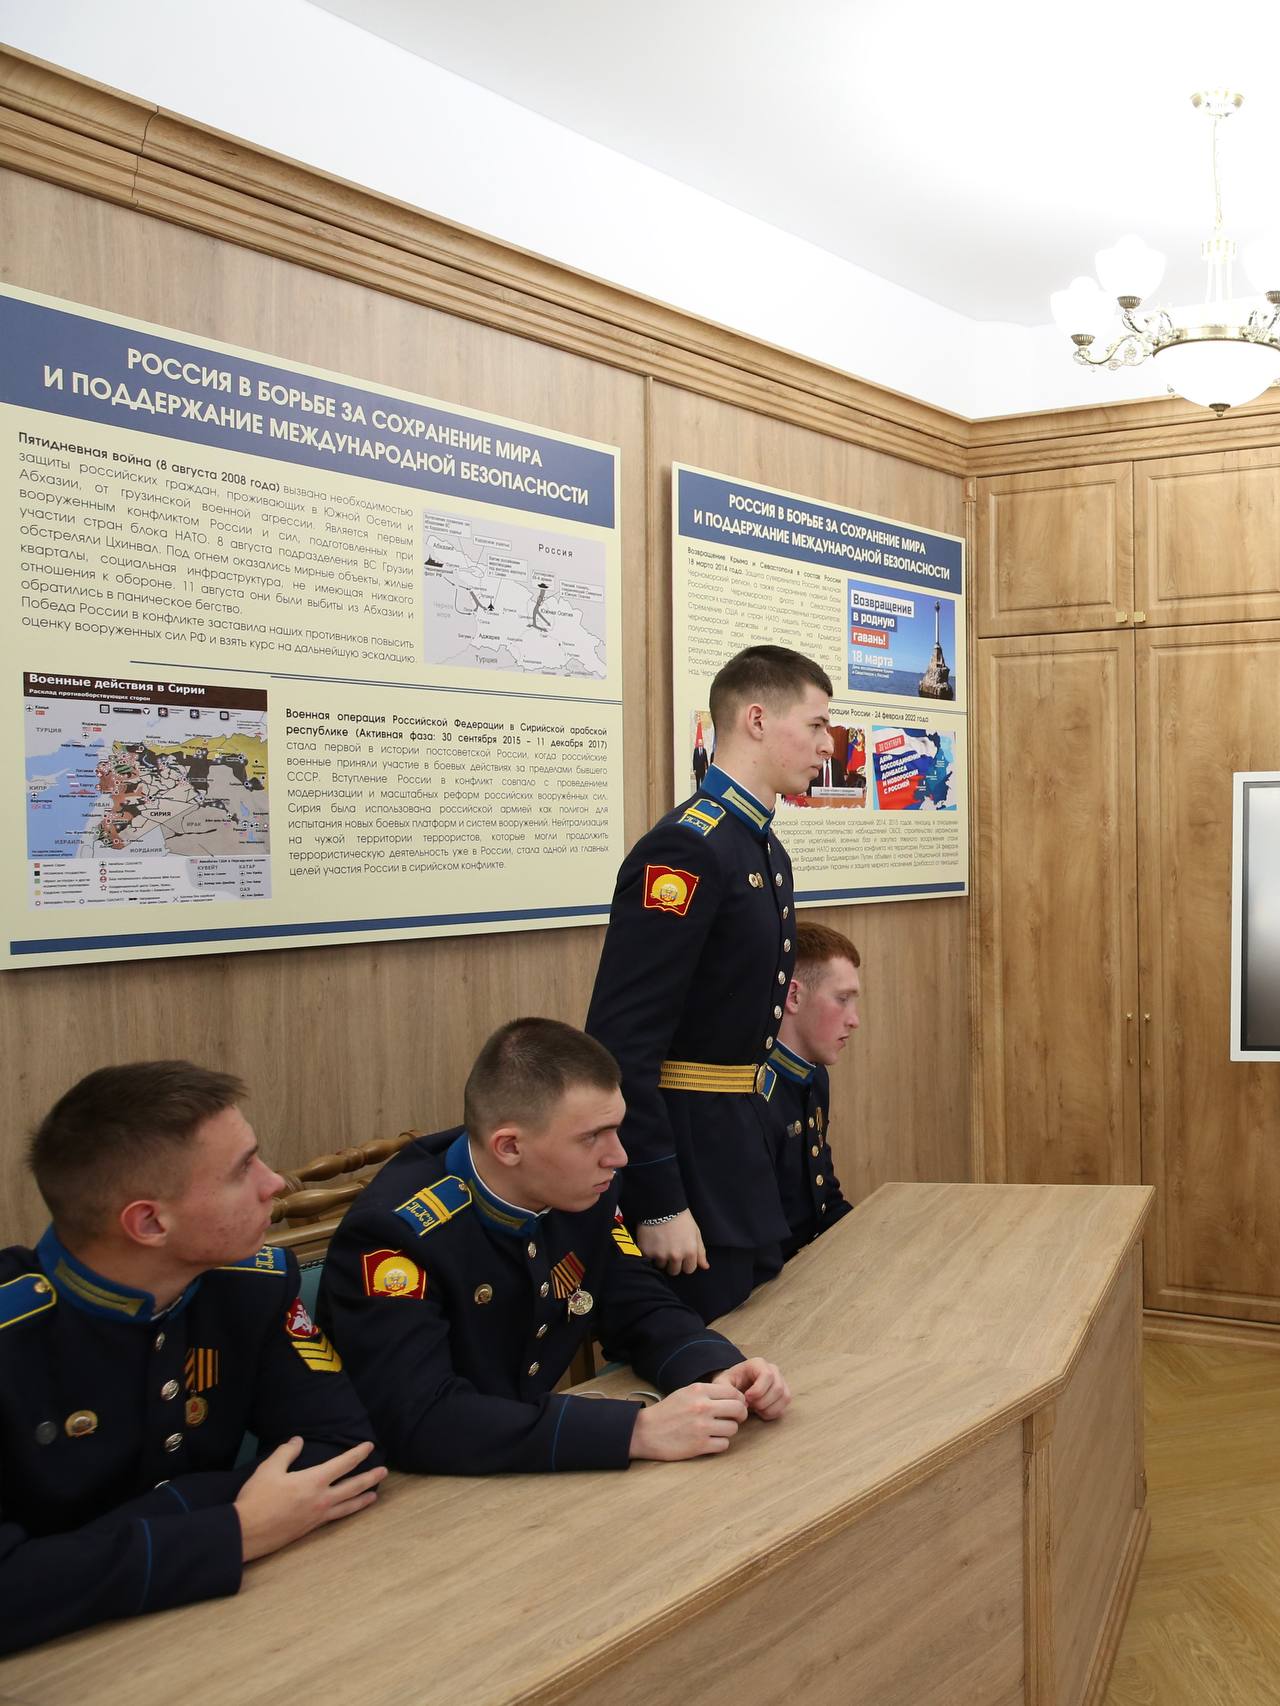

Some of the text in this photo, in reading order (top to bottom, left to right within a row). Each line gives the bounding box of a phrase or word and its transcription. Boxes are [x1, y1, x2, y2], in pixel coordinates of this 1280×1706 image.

[128, 347, 542, 467] РОССИЯ В БОРЬБЕ ЗА СОХРАНЕНИЕ МИРА
[44, 365, 588, 506] И ПОДДЕРЖАНИЕ МЕЖДУНАРОДНОЙ БЕЗОПАСНОСТИ
[18, 431, 413, 517] Пятидневная война (8 августа 2008 года) вызвана необходимостью
[18, 452, 70, 469] защиты
[79, 463, 157, 486] российских
[165, 479, 219, 497] граждан,
[226, 490, 305, 512] проживающих
[311, 506, 317, 514] в
[323, 506, 360, 522] Южной
[366, 514, 402, 529] Осетии
[407, 523, 413, 531] и
[18, 468, 413, 546] Абхазии, от грузинской военной агрессии. Является первым
[19, 488, 415, 561] вооруженным конфликтом России и сил, подготовленных при
[729, 493, 926, 555] РОССИЯ В БОРЬБЕ ЗА СОХРАНЕНИЕ МИРА
[538, 544, 572, 558] Россия
[694, 508, 949, 580] И ПОДДЕРЖАНИЕ МЕЖДУНАРОДНОЙ БЕЗОПАСНОСТИ
[853, 593, 912, 615] Возвращение
[853, 611, 894, 628] в родную
[853, 631, 885, 645] гавань!
[852, 649, 893, 668] 18 марта
[29, 673, 205, 695] Военные действия в Сирии
[29, 688, 57, 696] Расклад
[58, 690, 128, 700] противоборствующих
[286, 708, 607, 736] Военная операция Российской Федерации в Сирийской арабской
[904, 713, 916, 722] 2022
[286, 725, 348, 737] республике
[355, 728, 403, 739] (Активная
[409, 730, 435, 741] фаза:
[441, 732, 452, 742] 30
[457, 733, 497, 745] сентября
[502, 735, 521, 745] 2015
[537, 736, 544, 746] 11
[550, 738, 583, 749] декабря
[588, 739, 607, 750] 2017)
